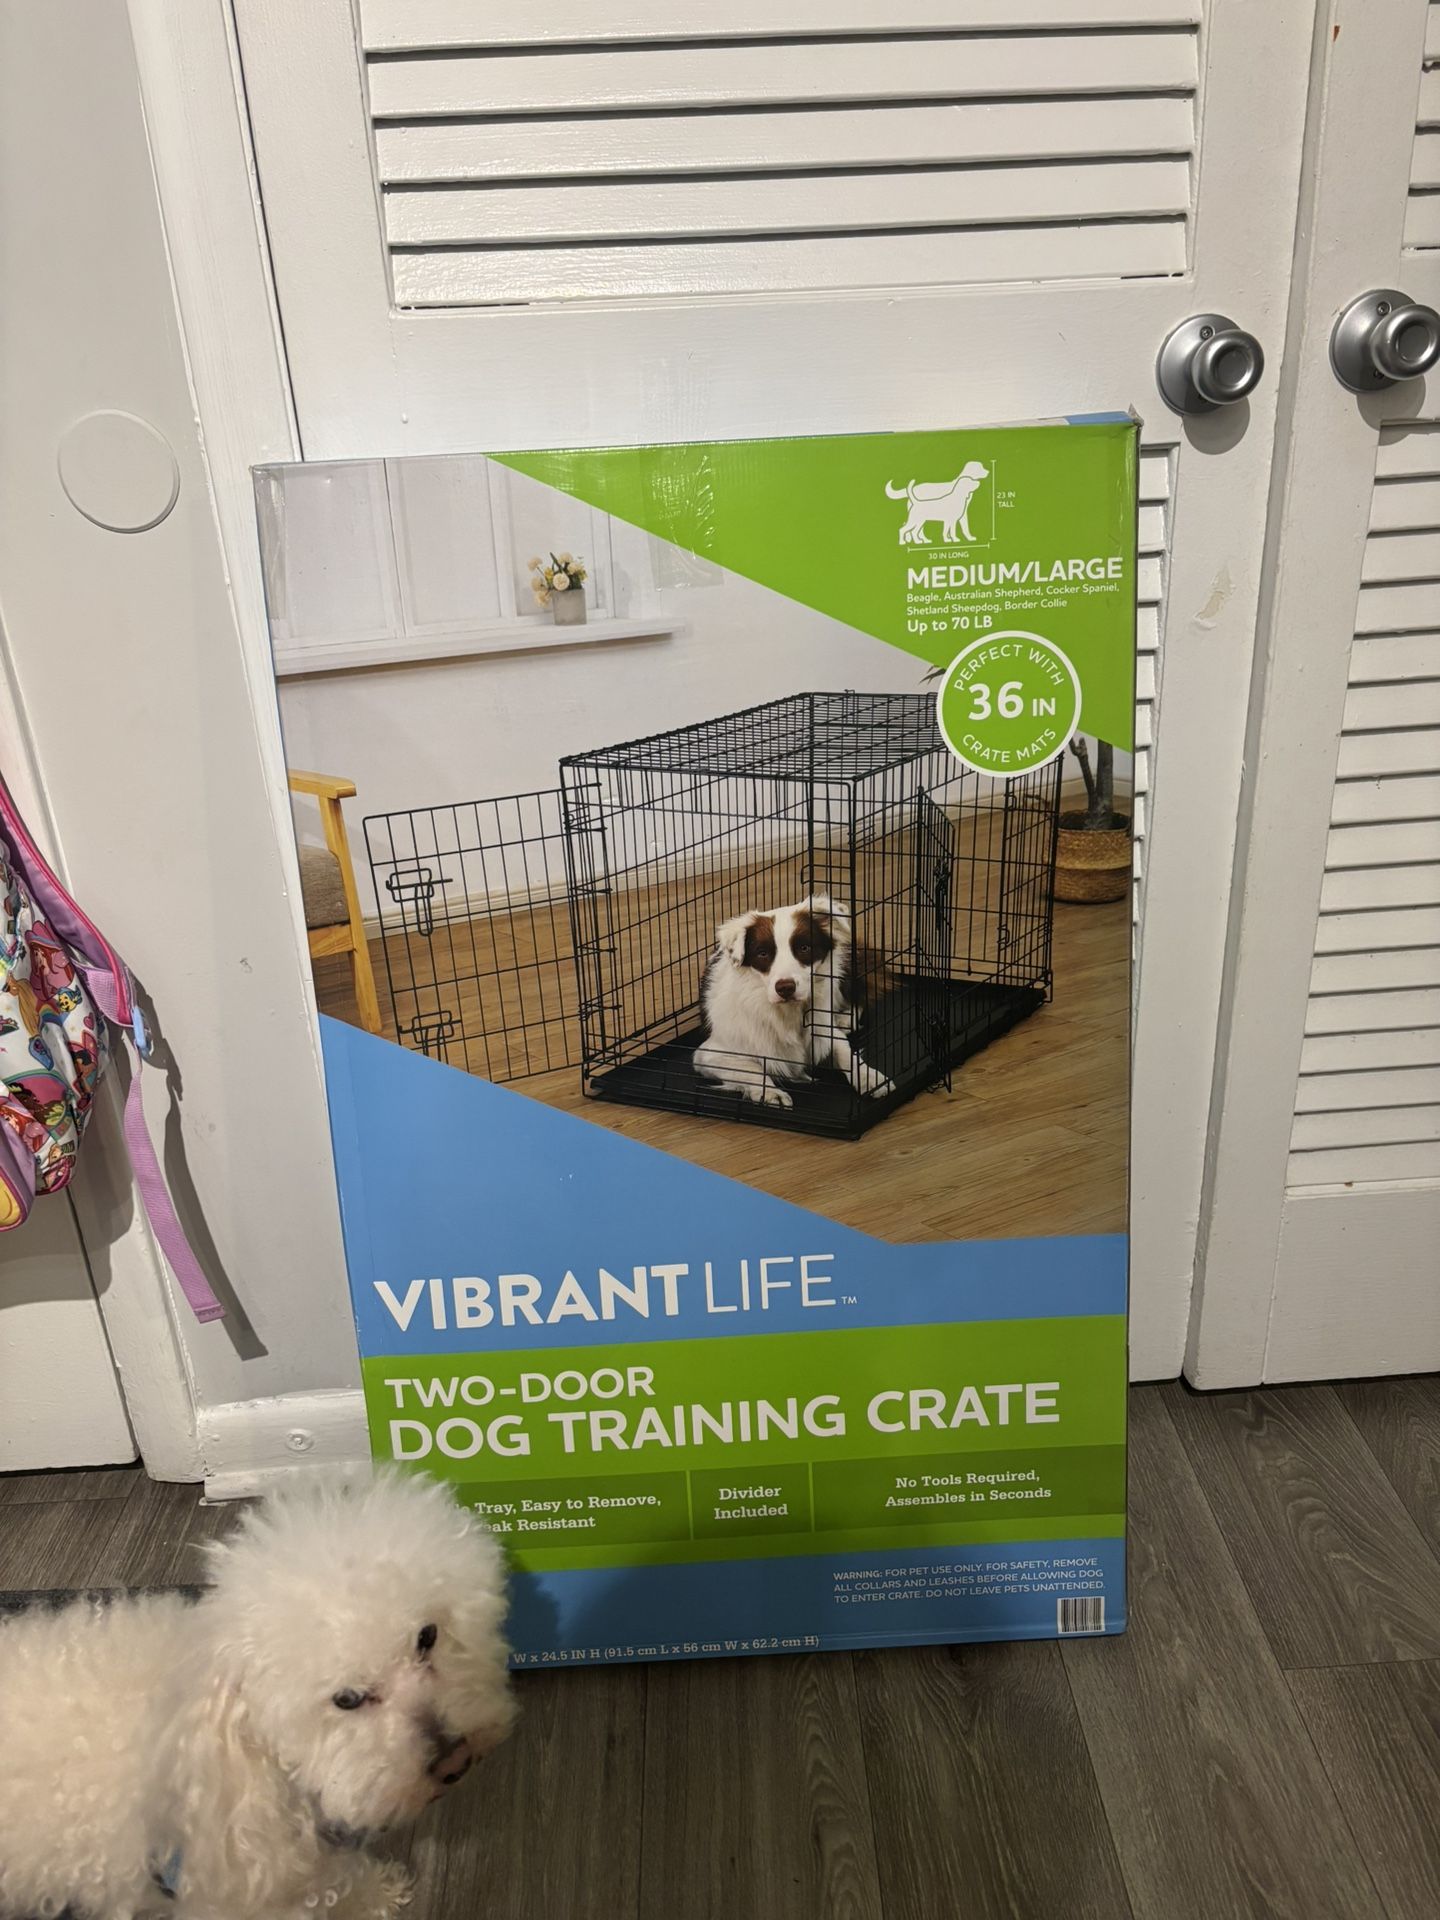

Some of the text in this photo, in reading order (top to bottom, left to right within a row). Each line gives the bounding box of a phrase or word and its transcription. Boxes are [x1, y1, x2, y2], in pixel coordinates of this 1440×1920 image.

[996, 491, 1006, 499] 23
[928, 552, 938, 560] 30
[948, 551, 969, 559] LONG
[907, 557, 1123, 589] MEDIUM/LARGE
[943, 589, 992, 601] Australian
[1046, 585, 1080, 595] Cocker
[906, 605, 949, 616] Shetland
[1004, 600, 1038, 611] Border
[1040, 598, 1068, 608] Collie
[907, 615, 993, 636] Up to 70 LB
[953, 644, 1065, 691] PERFECT WITH
[967, 680, 1056, 721] 36 IN
[962, 727, 1056, 763] CRATE MATS
[373, 1263, 689, 1332] VIBRANT
[704, 1253, 837, 1314] LIFE
[384, 1366, 656, 1409] TWO-DOOR
[389, 1381, 1060, 1461] DOG TRAINING CRATE
[895, 1468, 1041, 1489] No Tools Required,
[718, 1485, 782, 1500] Divider
[884, 1487, 1053, 1508] Assembles in Seconds
[474, 1501, 517, 1516] Tray,
[521, 1499, 561, 1513] Easy
[566, 1499, 584, 1511] to
[587, 1494, 662, 1509] Remove,
[713, 1503, 789, 1520] Included
[516, 1516, 597, 1532] Resistant
[833, 1570, 883, 1581] WARNING:
[885, 1568, 907, 1578] FOR
[909, 1566, 929, 1576] PET
[931, 1565, 952, 1575] USE
[954, 1563, 984, 1573] ONLY.
[986, 1562, 1008, 1572] FOR
[1053, 1557, 1098, 1568] REMOVE
[834, 1568, 1104, 1593] ALL COLLARS AND LEASHES BEFORE ALLOWING DOG
[834, 1580, 1106, 1604] TO ENTER CRATE. DO NOT LEAVE PETS UNATTENDED.
[513, 1635, 820, 1664] W x 24.5 IN H (91.5 cm L x 56 cm W x 62.2 cm H)
